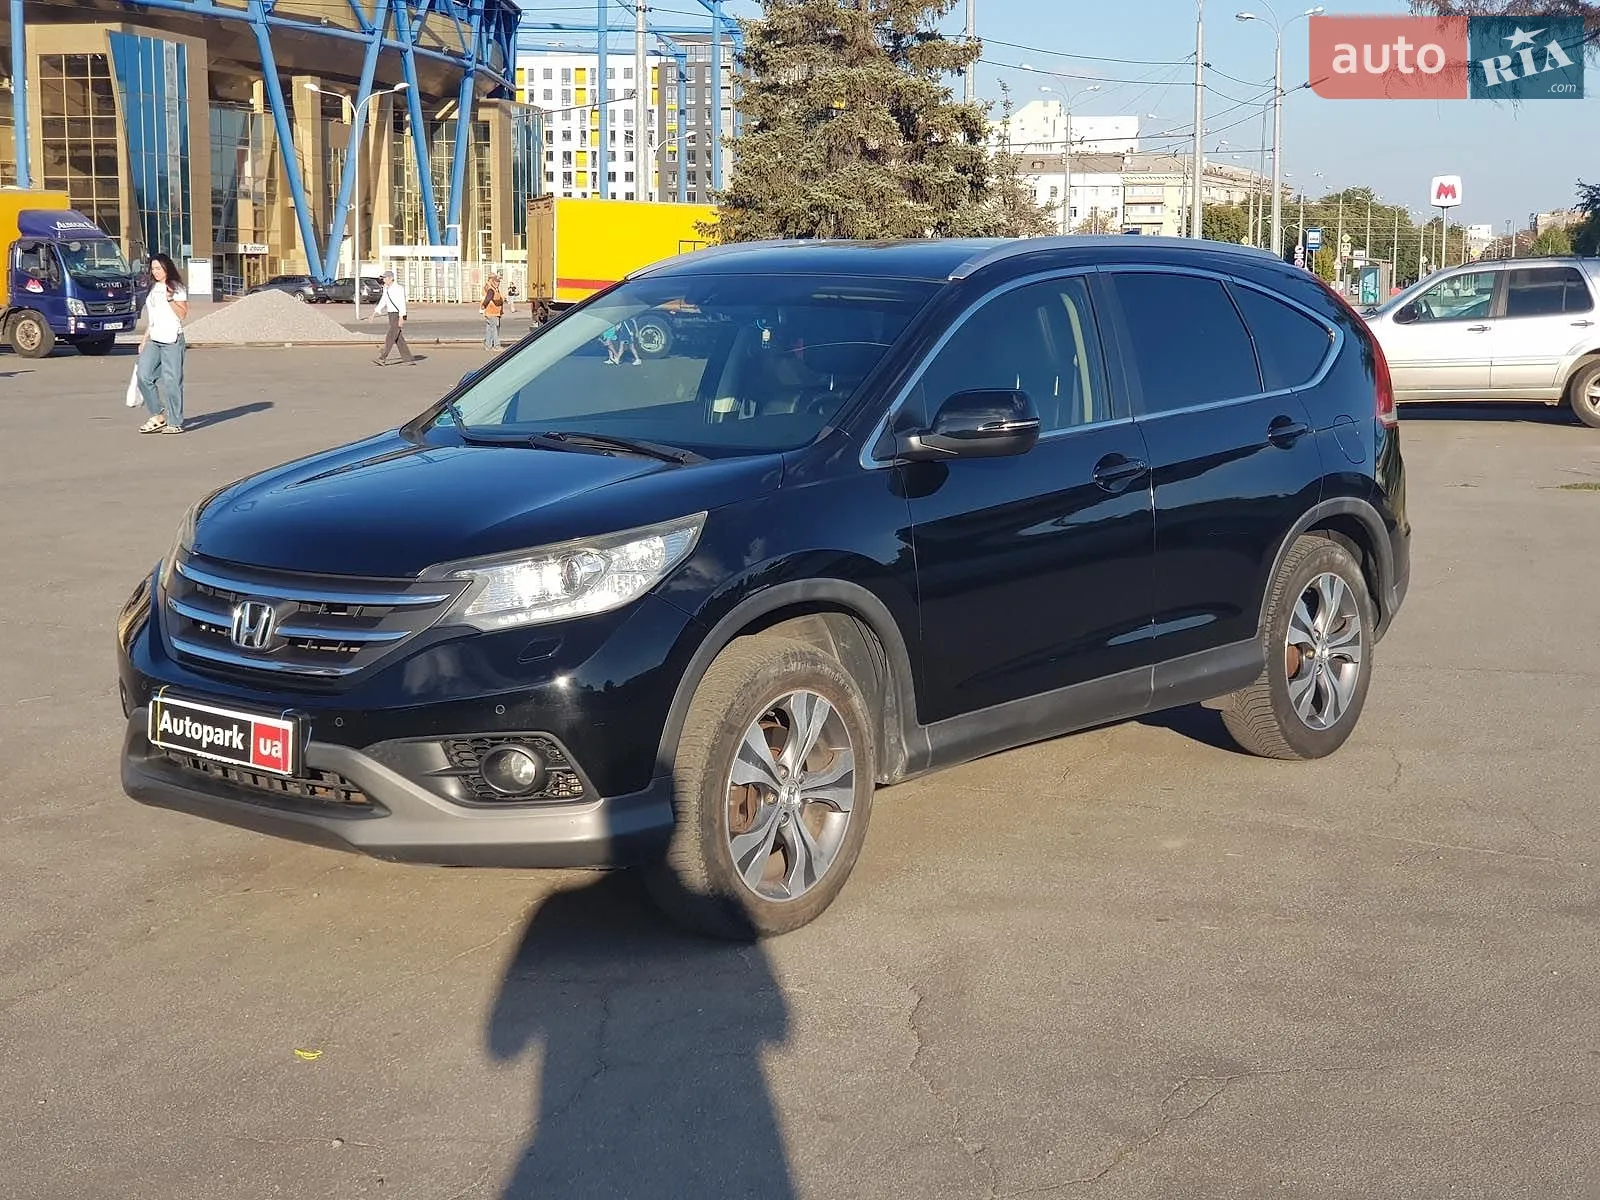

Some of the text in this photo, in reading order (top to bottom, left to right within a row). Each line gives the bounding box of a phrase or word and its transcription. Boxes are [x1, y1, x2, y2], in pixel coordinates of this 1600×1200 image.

[1436, 182, 1457, 199] M
[159, 710, 246, 750] Autopark
[259, 737, 283, 760] ua
